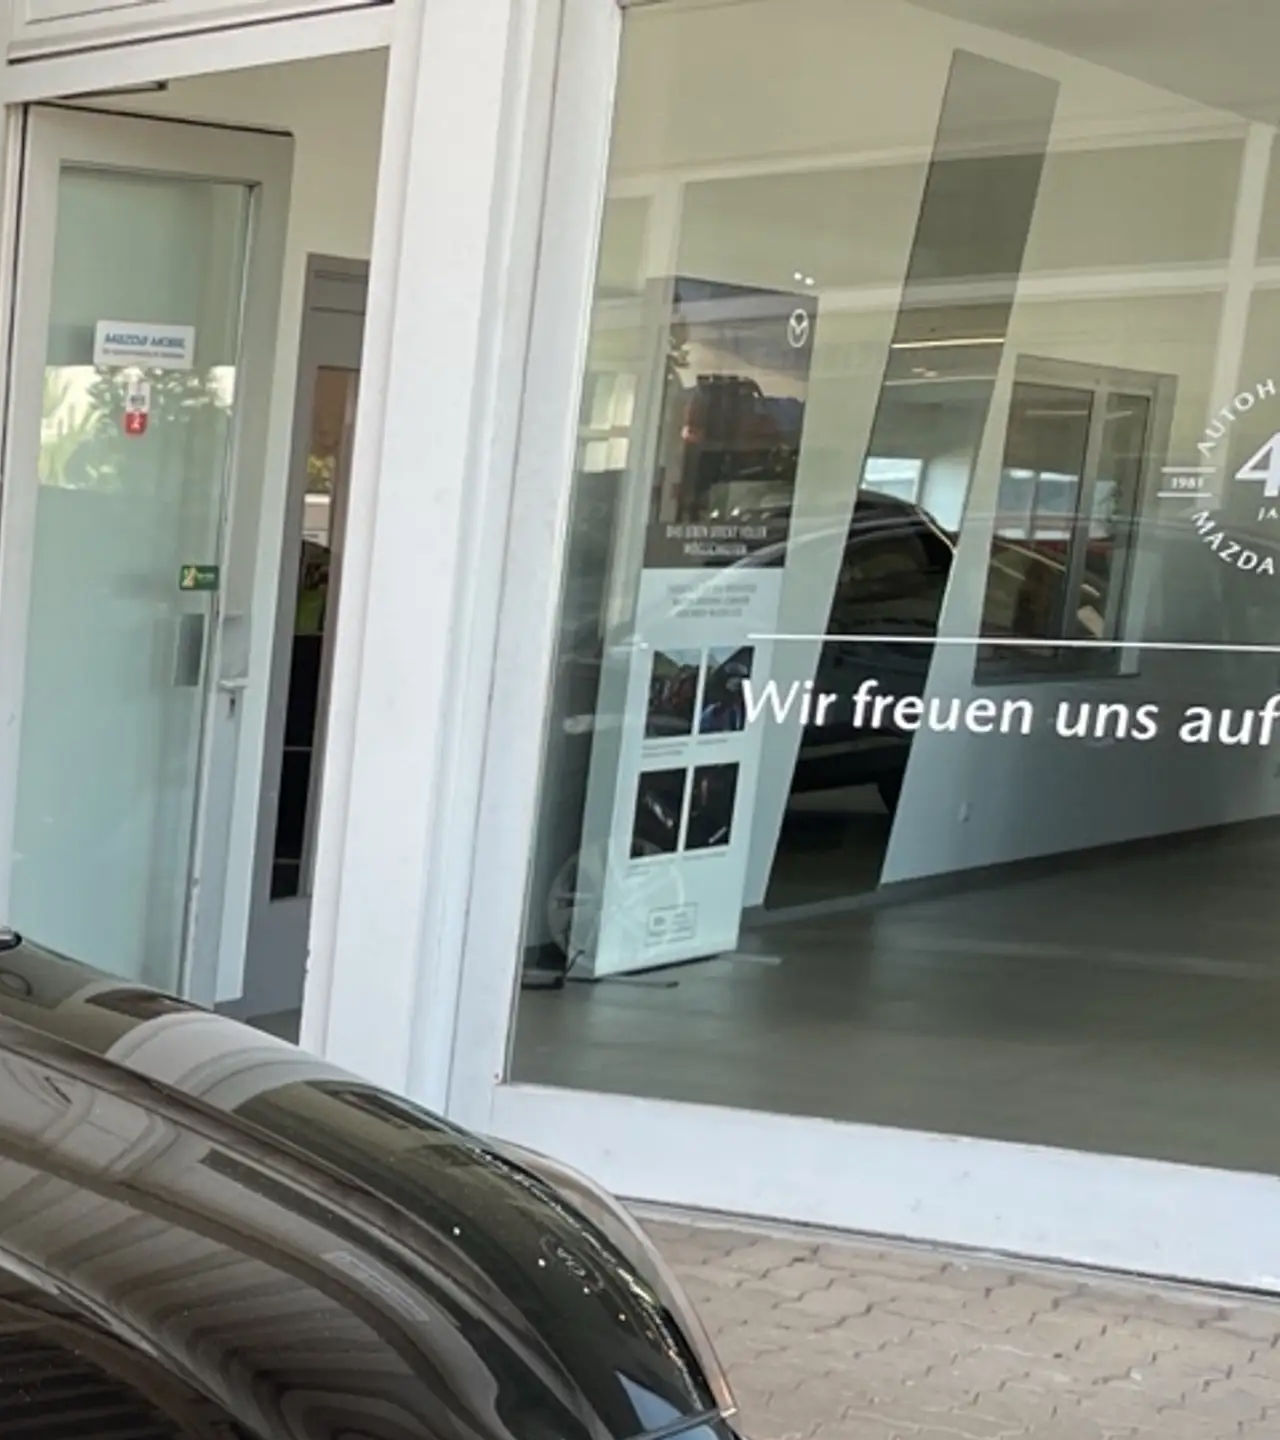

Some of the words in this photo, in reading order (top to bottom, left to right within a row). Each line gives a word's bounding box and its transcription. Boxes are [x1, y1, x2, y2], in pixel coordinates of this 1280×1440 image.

[1197, 379, 1277, 459] AUTOH
[1192, 509, 1276, 575] MAZDA
[741, 678, 837, 727] Wir
[851, 679, 1034, 736] freuen
[1055, 702, 1159, 741] uns
[1179, 694, 1280, 746] auf
